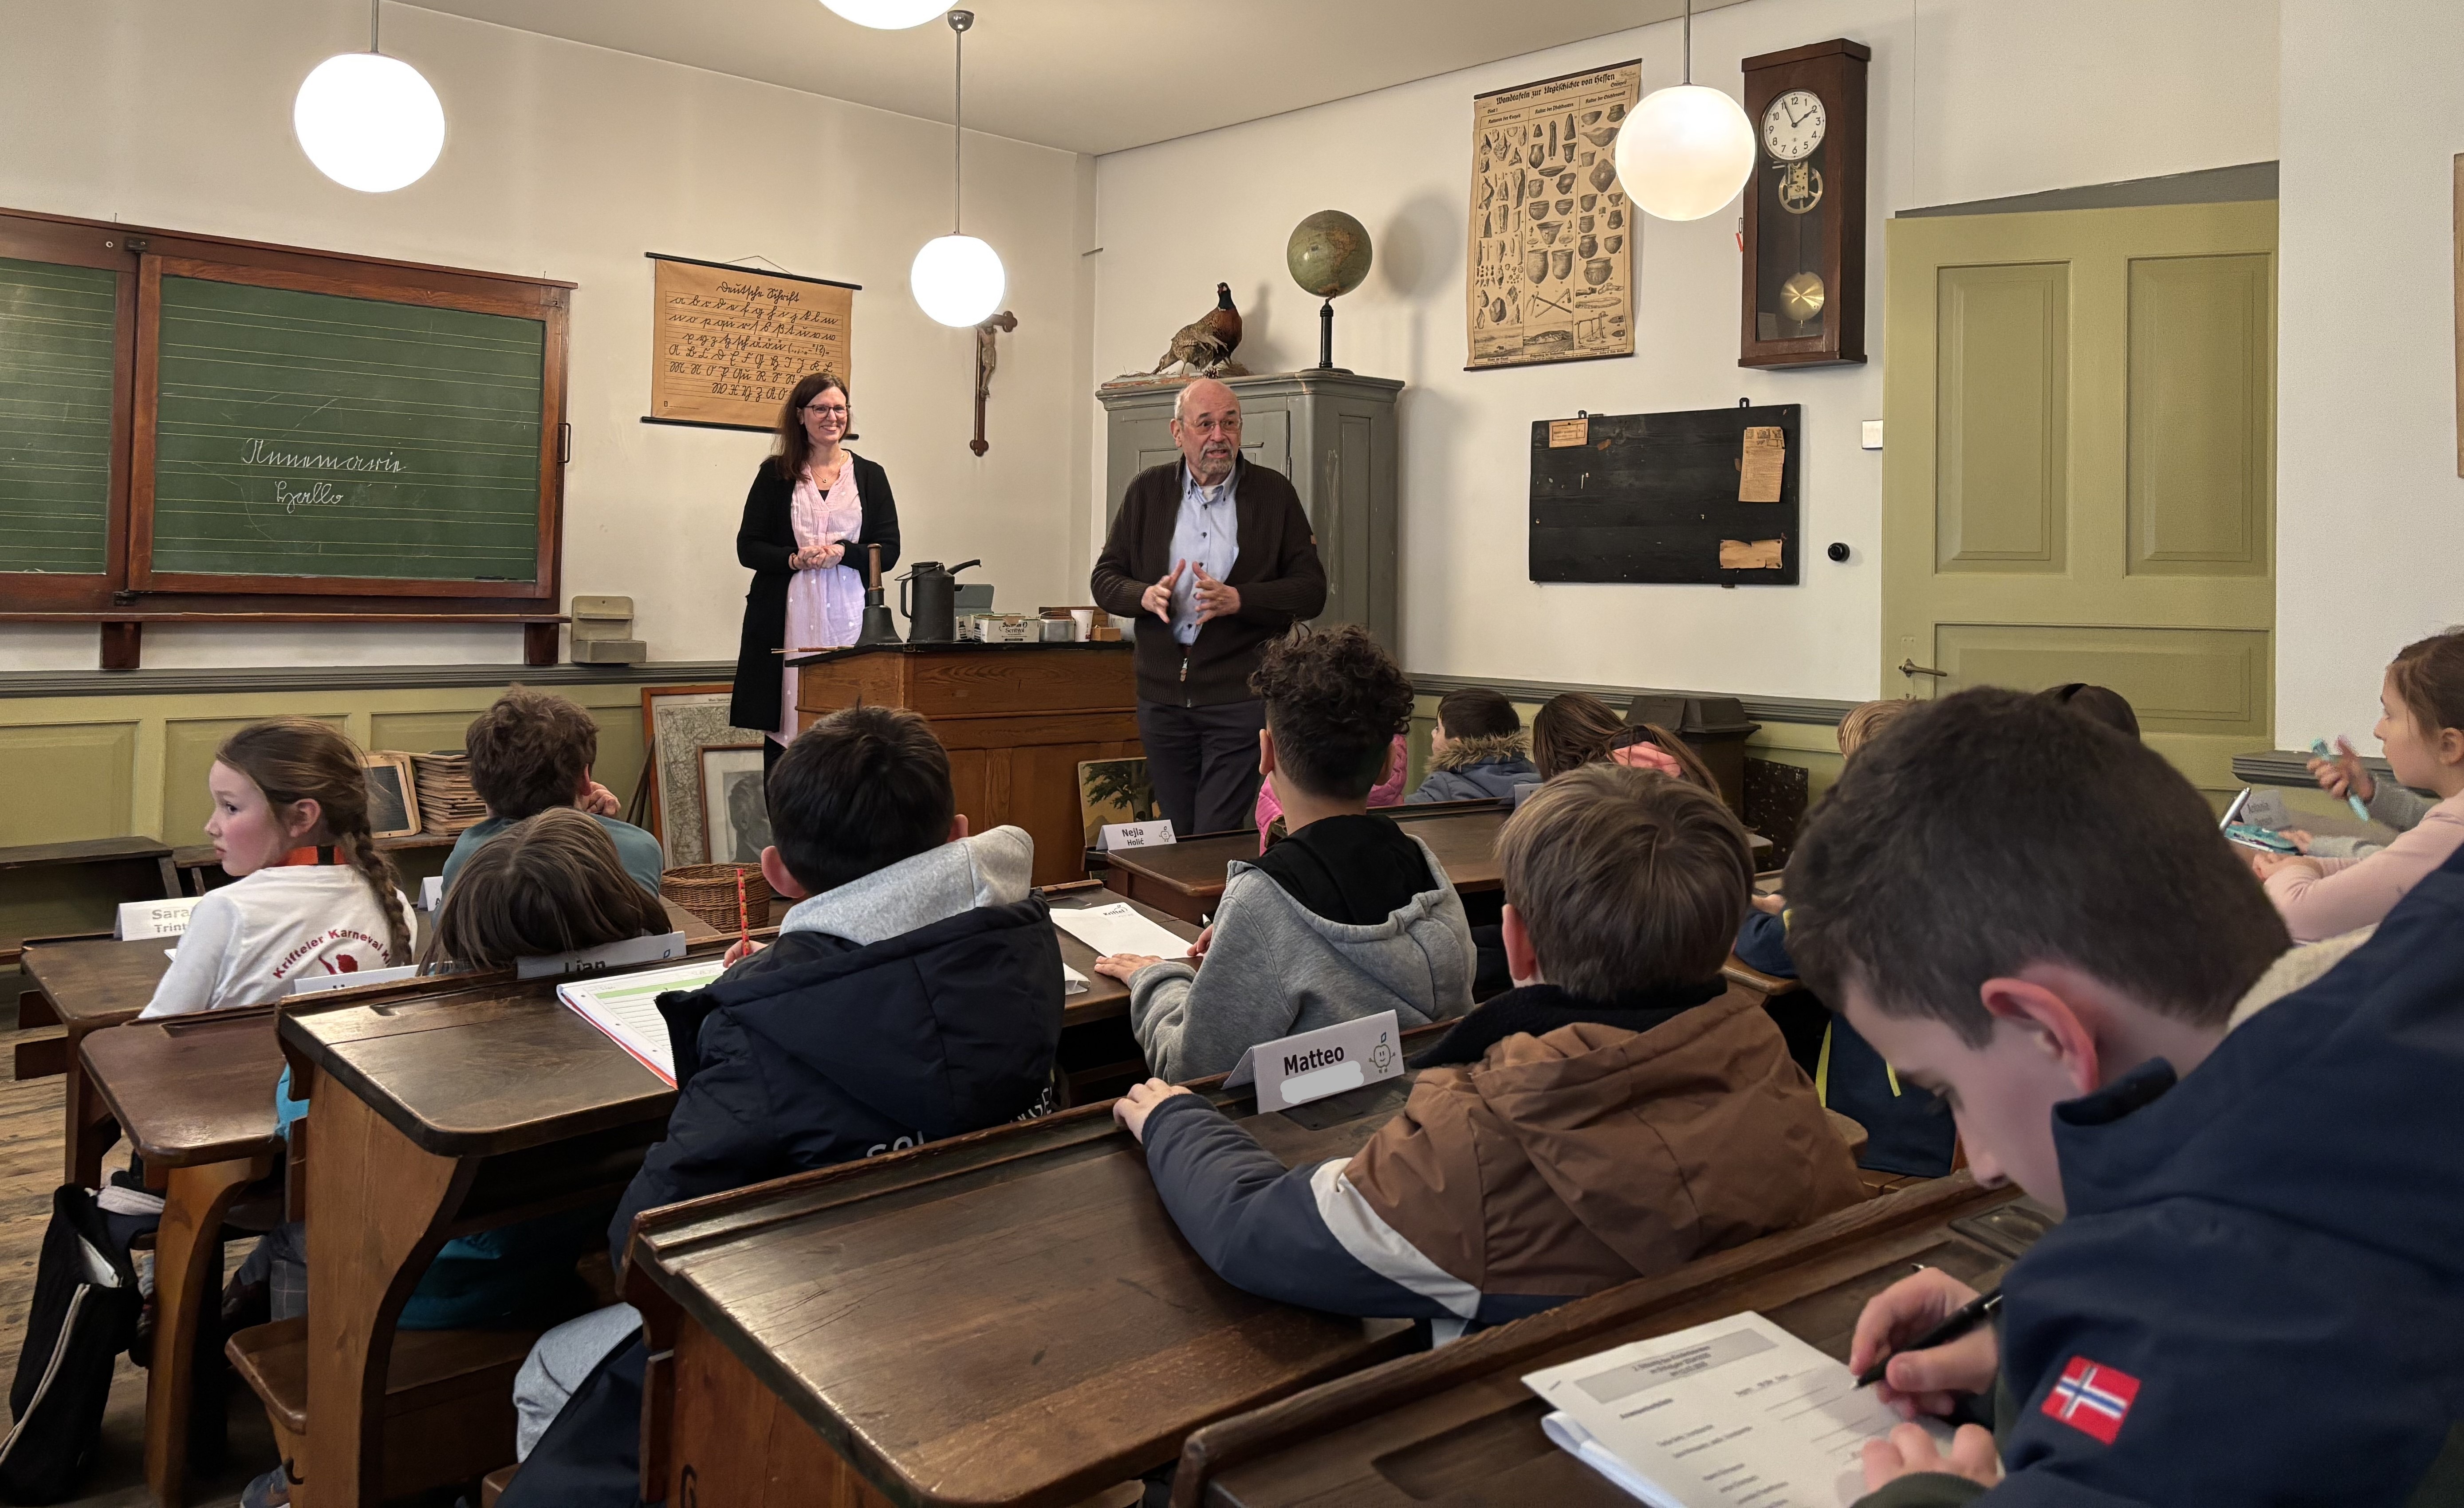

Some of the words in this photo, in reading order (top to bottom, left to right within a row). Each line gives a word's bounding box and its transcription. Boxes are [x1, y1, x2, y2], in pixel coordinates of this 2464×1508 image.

[1496, 91, 1530, 105] Wandtafeln
[1531, 90, 1541, 98] zur
[1594, 74, 1614, 84] Hessen
[1773, 112, 1779, 121] 10
[1816, 117, 1820, 126] 3
[1769, 126, 1774, 134] 9
[1773, 137, 1777, 145] 8
[1804, 141, 1808, 149] 5
[716, 281, 764, 301] Deutsche
[767, 288, 799, 306] Schrift
[752, 307, 764, 319] g
[773, 323, 784, 338] ß
[1122, 828, 1144, 837] Nejla
[154, 923, 187, 932] Trint
[273, 937, 323, 978] Krifteler
[328, 929, 384, 951] Karneval
[1284, 1046, 1344, 1076] Matteo
